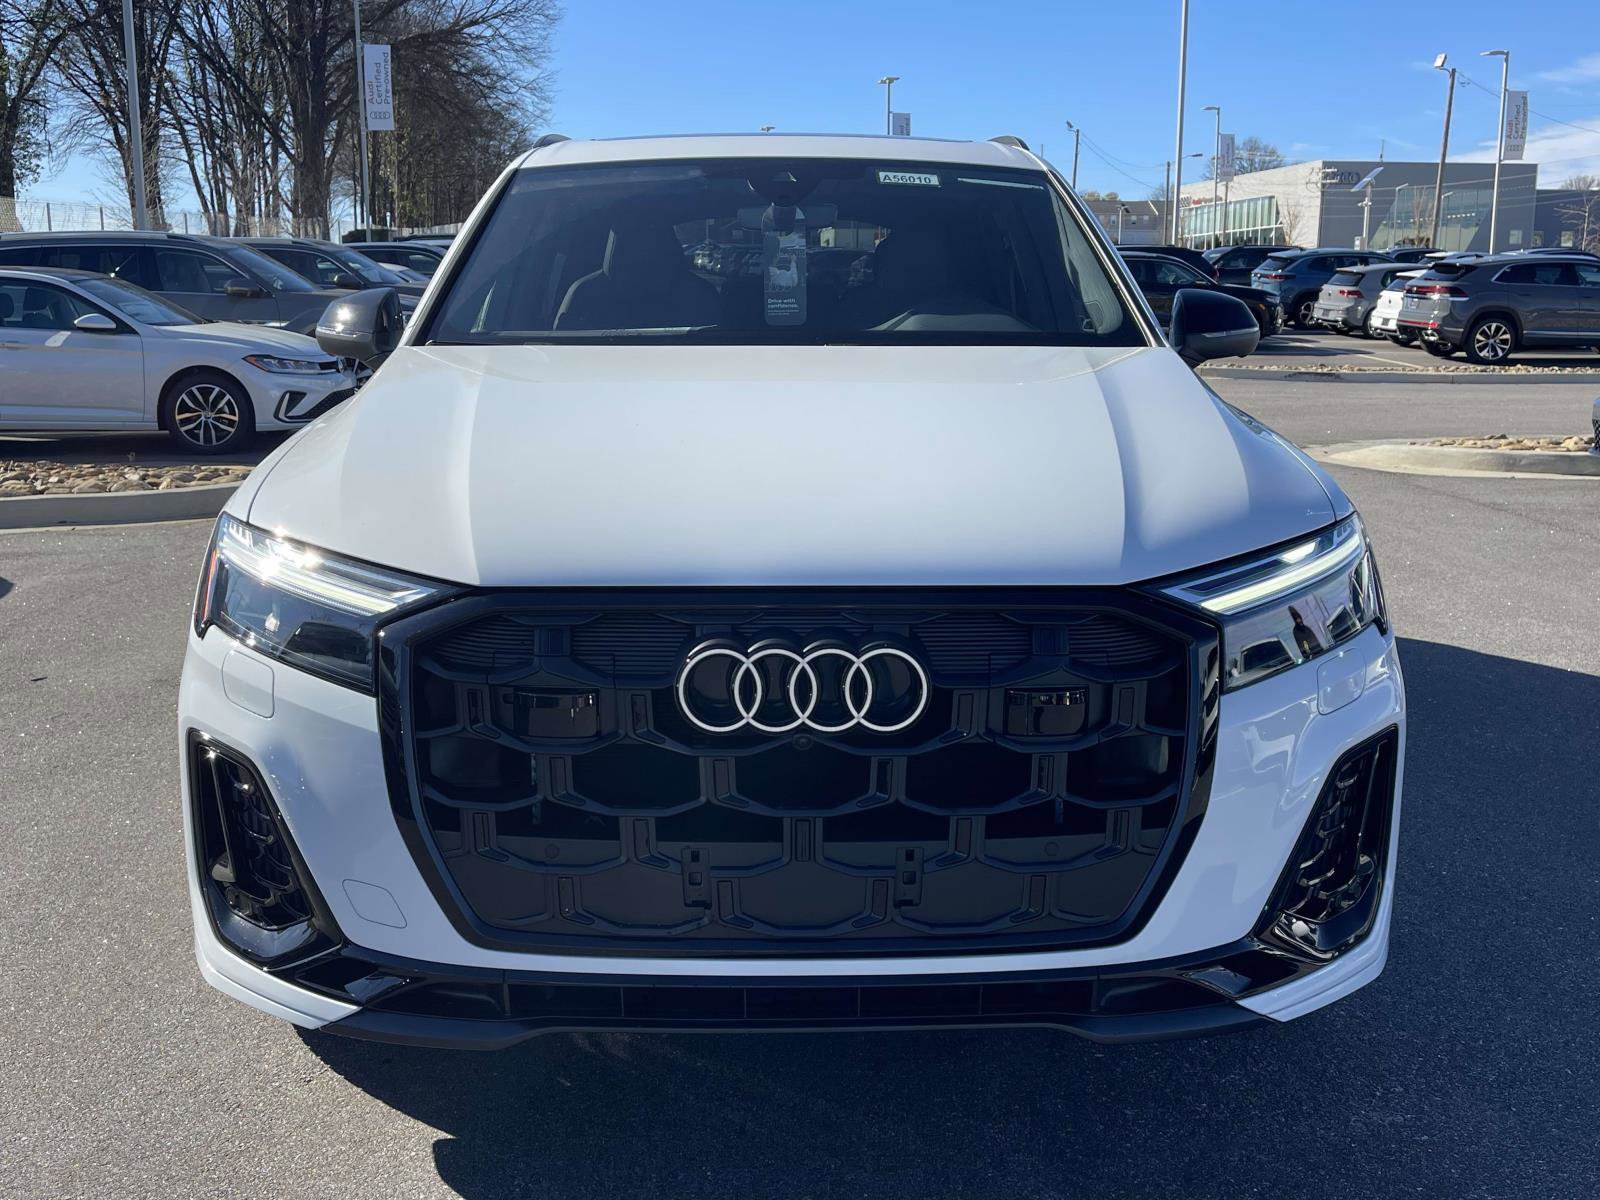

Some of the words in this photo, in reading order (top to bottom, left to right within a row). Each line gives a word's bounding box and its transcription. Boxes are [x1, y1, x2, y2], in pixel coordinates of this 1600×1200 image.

[374, 62, 382, 105] Certified
[382, 52, 391, 105] Pre-owned
[1512, 104, 1521, 140] Certified
[882, 174, 932, 184] A56010
